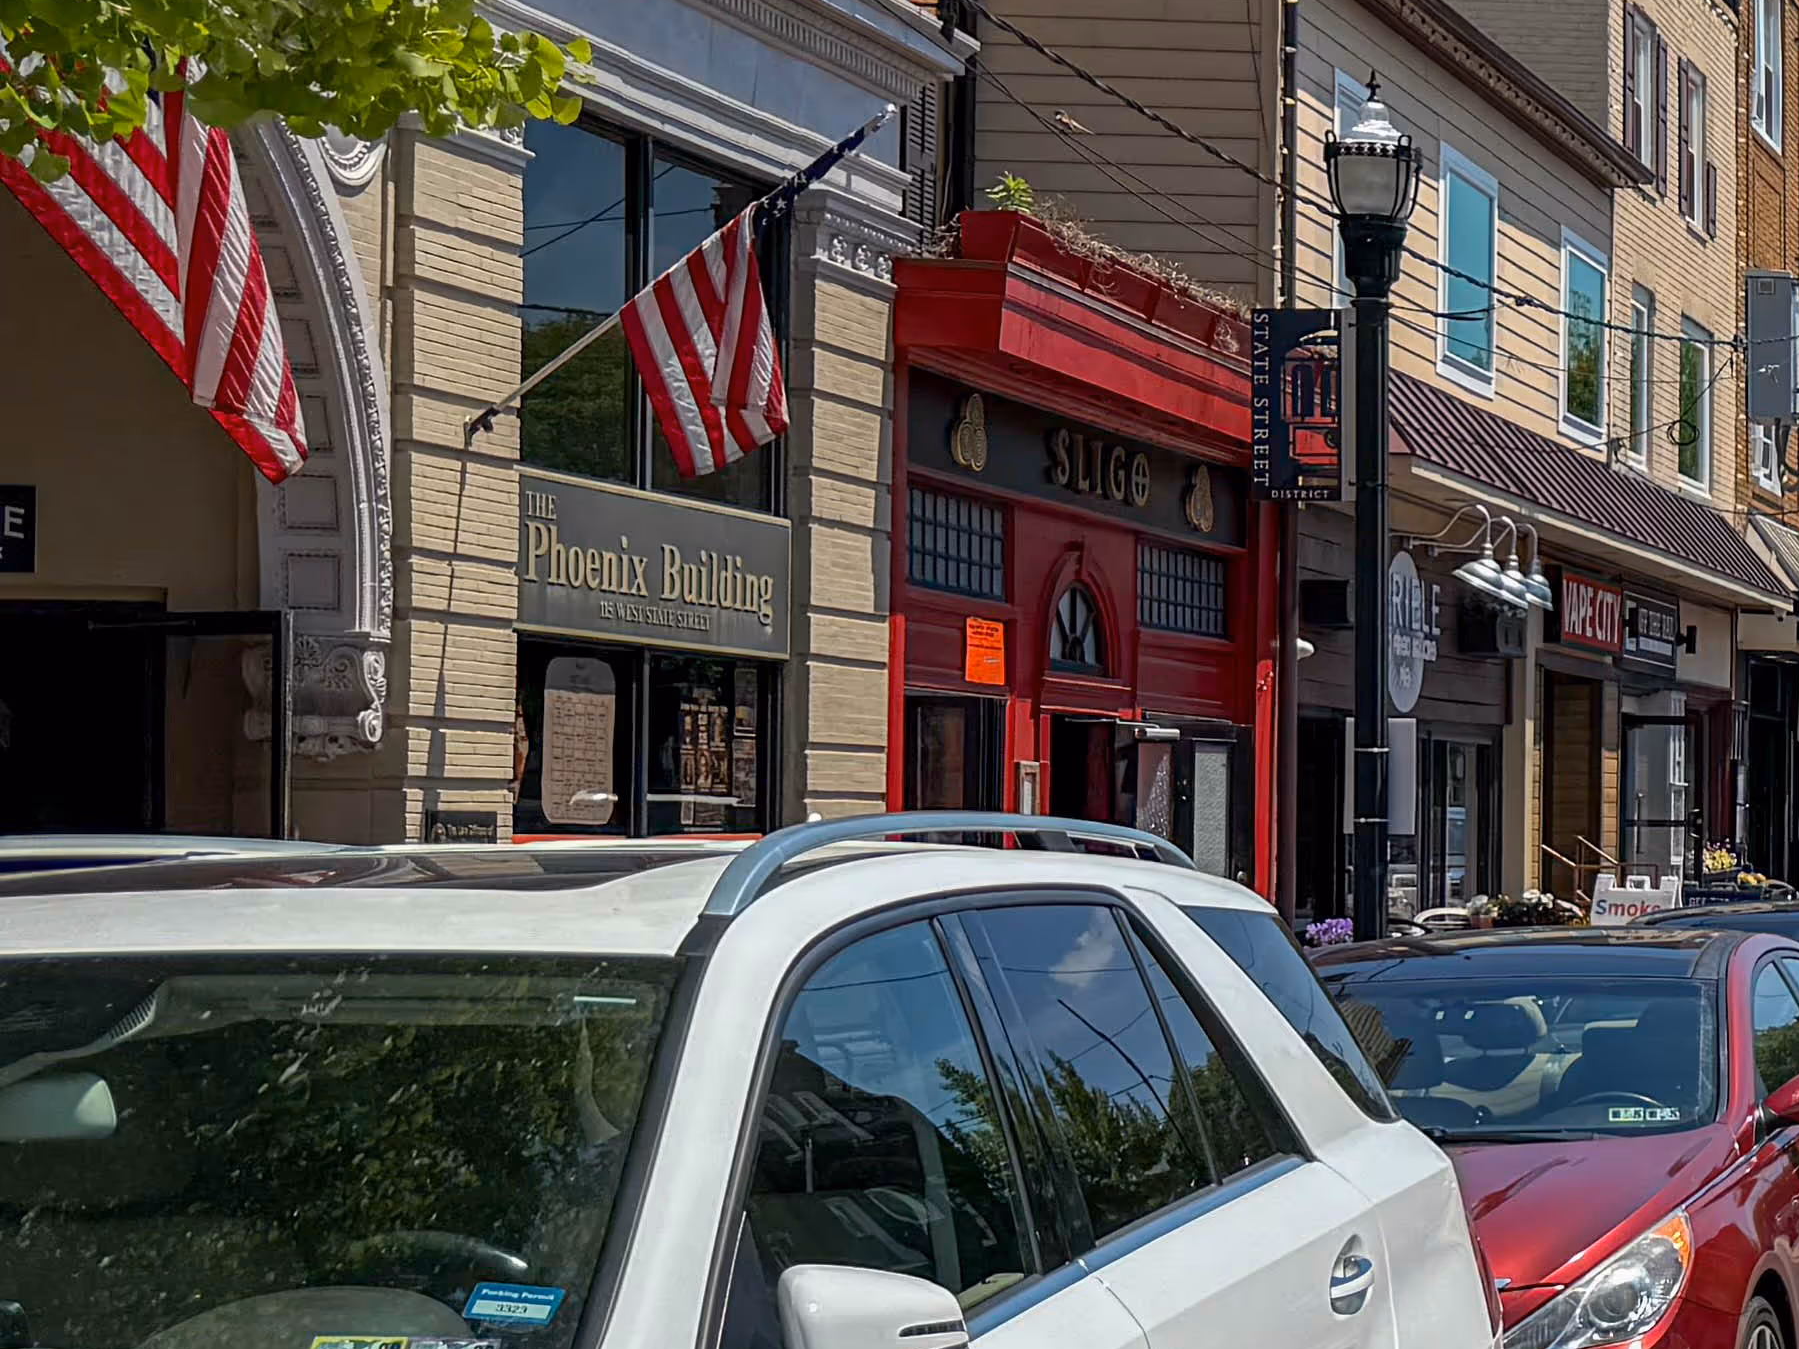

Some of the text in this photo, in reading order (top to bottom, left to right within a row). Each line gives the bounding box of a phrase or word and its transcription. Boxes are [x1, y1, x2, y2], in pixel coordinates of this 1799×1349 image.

[1254, 312, 1269, 487] STATE STREET
[1053, 428, 1150, 507] SLIGO
[526, 490, 557, 519] THE
[1271, 489, 1330, 499] DISTRICT
[524, 520, 774, 629] Phoenix Building
[616, 603, 644, 624] WEST
[645, 606, 674, 628] STATE
[676, 611, 711, 632] STREET
[1562, 578, 1594, 638] VAPE
[1595, 589, 1621, 644] CITY
[481, 1288, 554, 1301] Parking Permit
